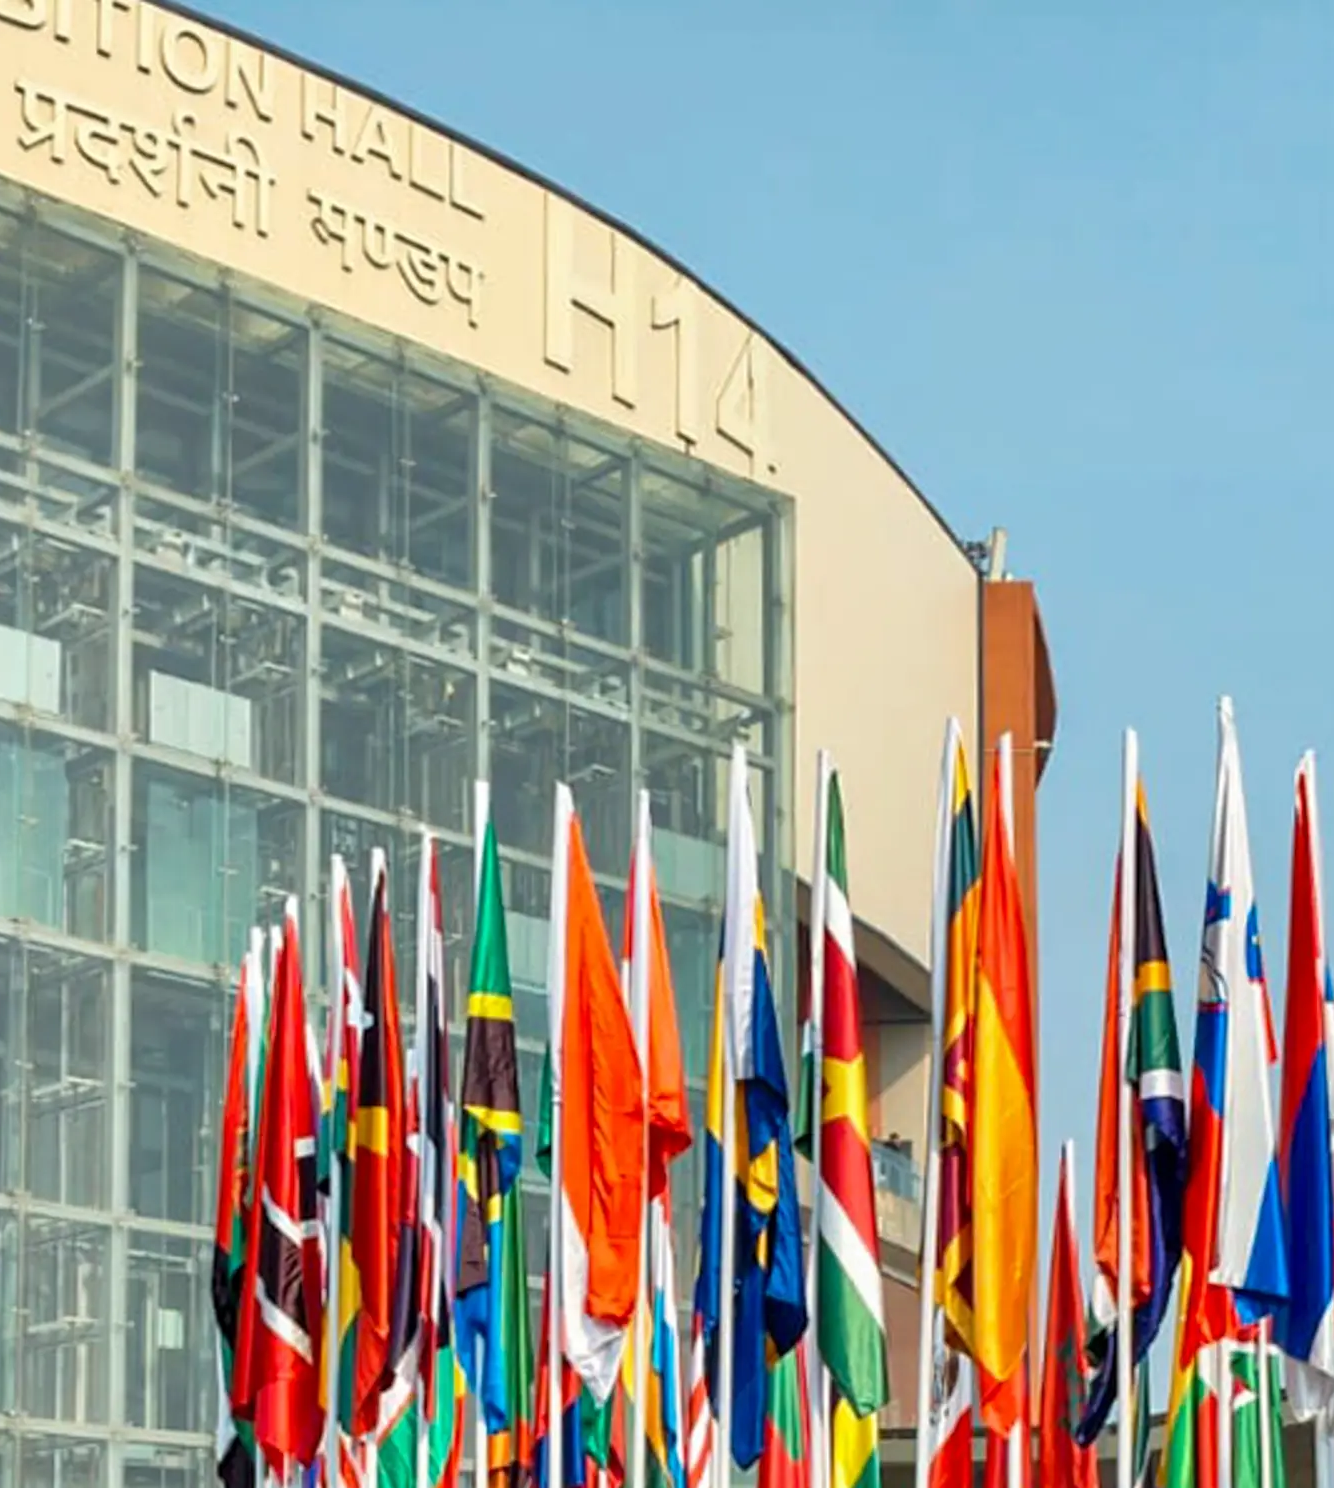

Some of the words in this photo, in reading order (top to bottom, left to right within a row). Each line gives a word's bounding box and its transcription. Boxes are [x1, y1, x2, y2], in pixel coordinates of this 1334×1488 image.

[13, 74, 276, 239] प्रदर्शनी
[306, 187, 487, 330] मण्डप
[299, 70, 486, 221] HALL
